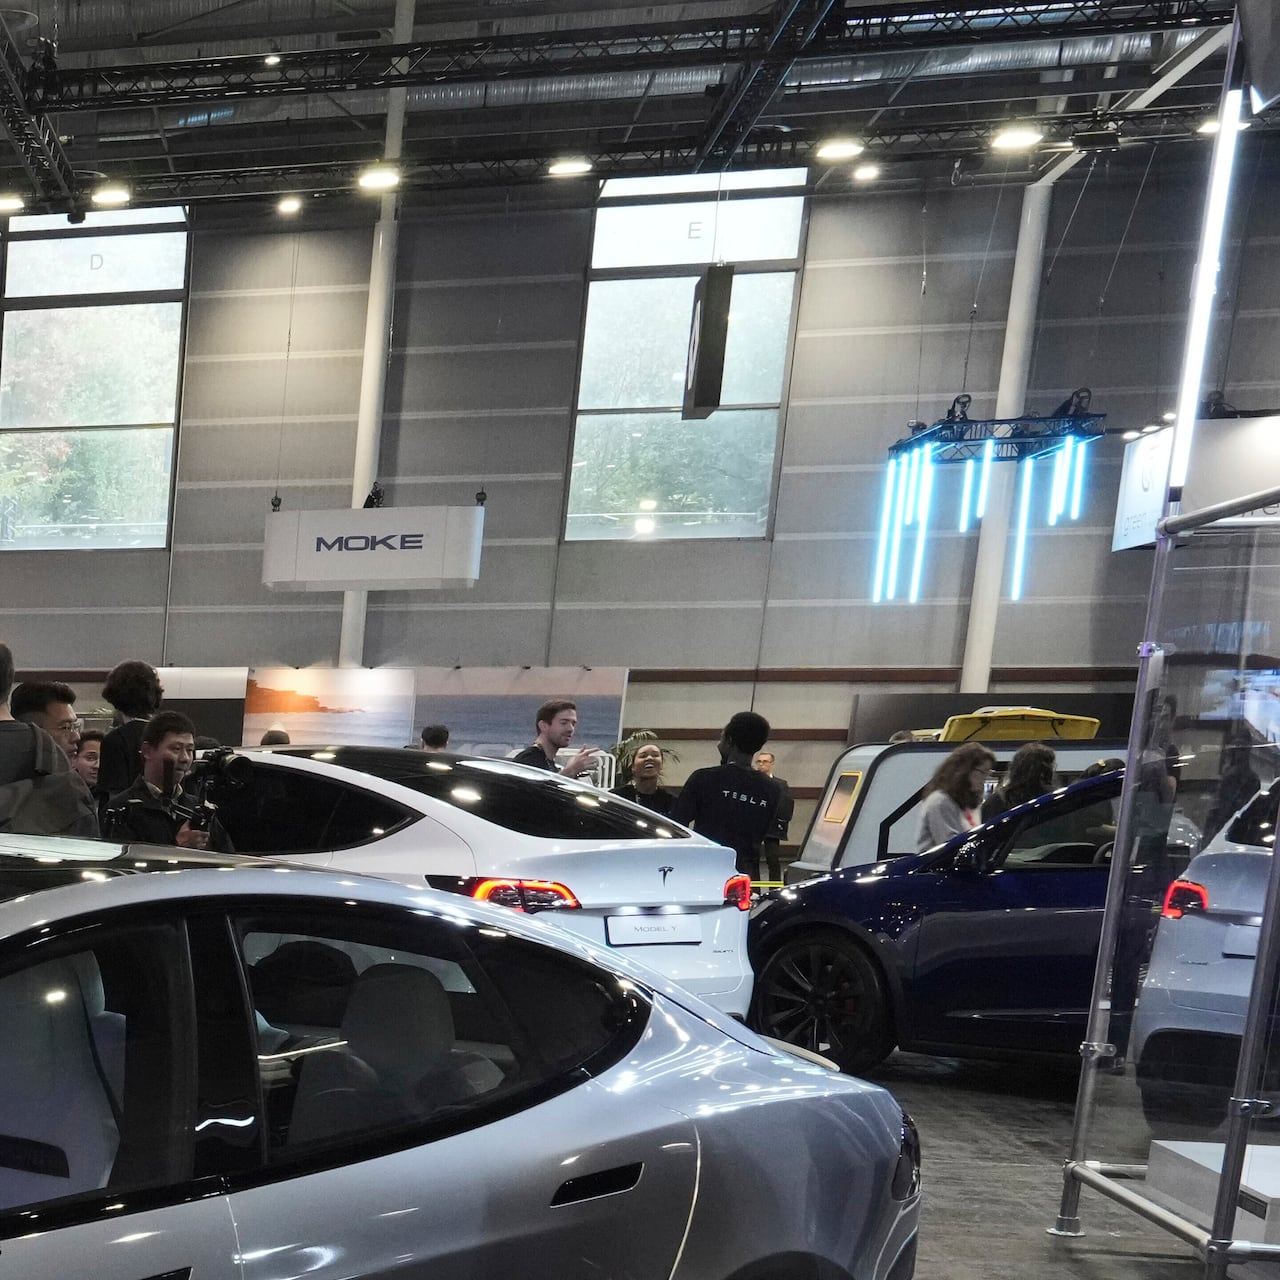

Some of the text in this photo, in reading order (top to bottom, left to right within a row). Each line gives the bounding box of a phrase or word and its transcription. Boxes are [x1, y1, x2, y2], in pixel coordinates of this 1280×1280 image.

[688, 221, 702, 239] E
[90, 254, 103, 270] D
[316, 534, 424, 552] MOKE
[723, 790, 767, 807] TESLA
